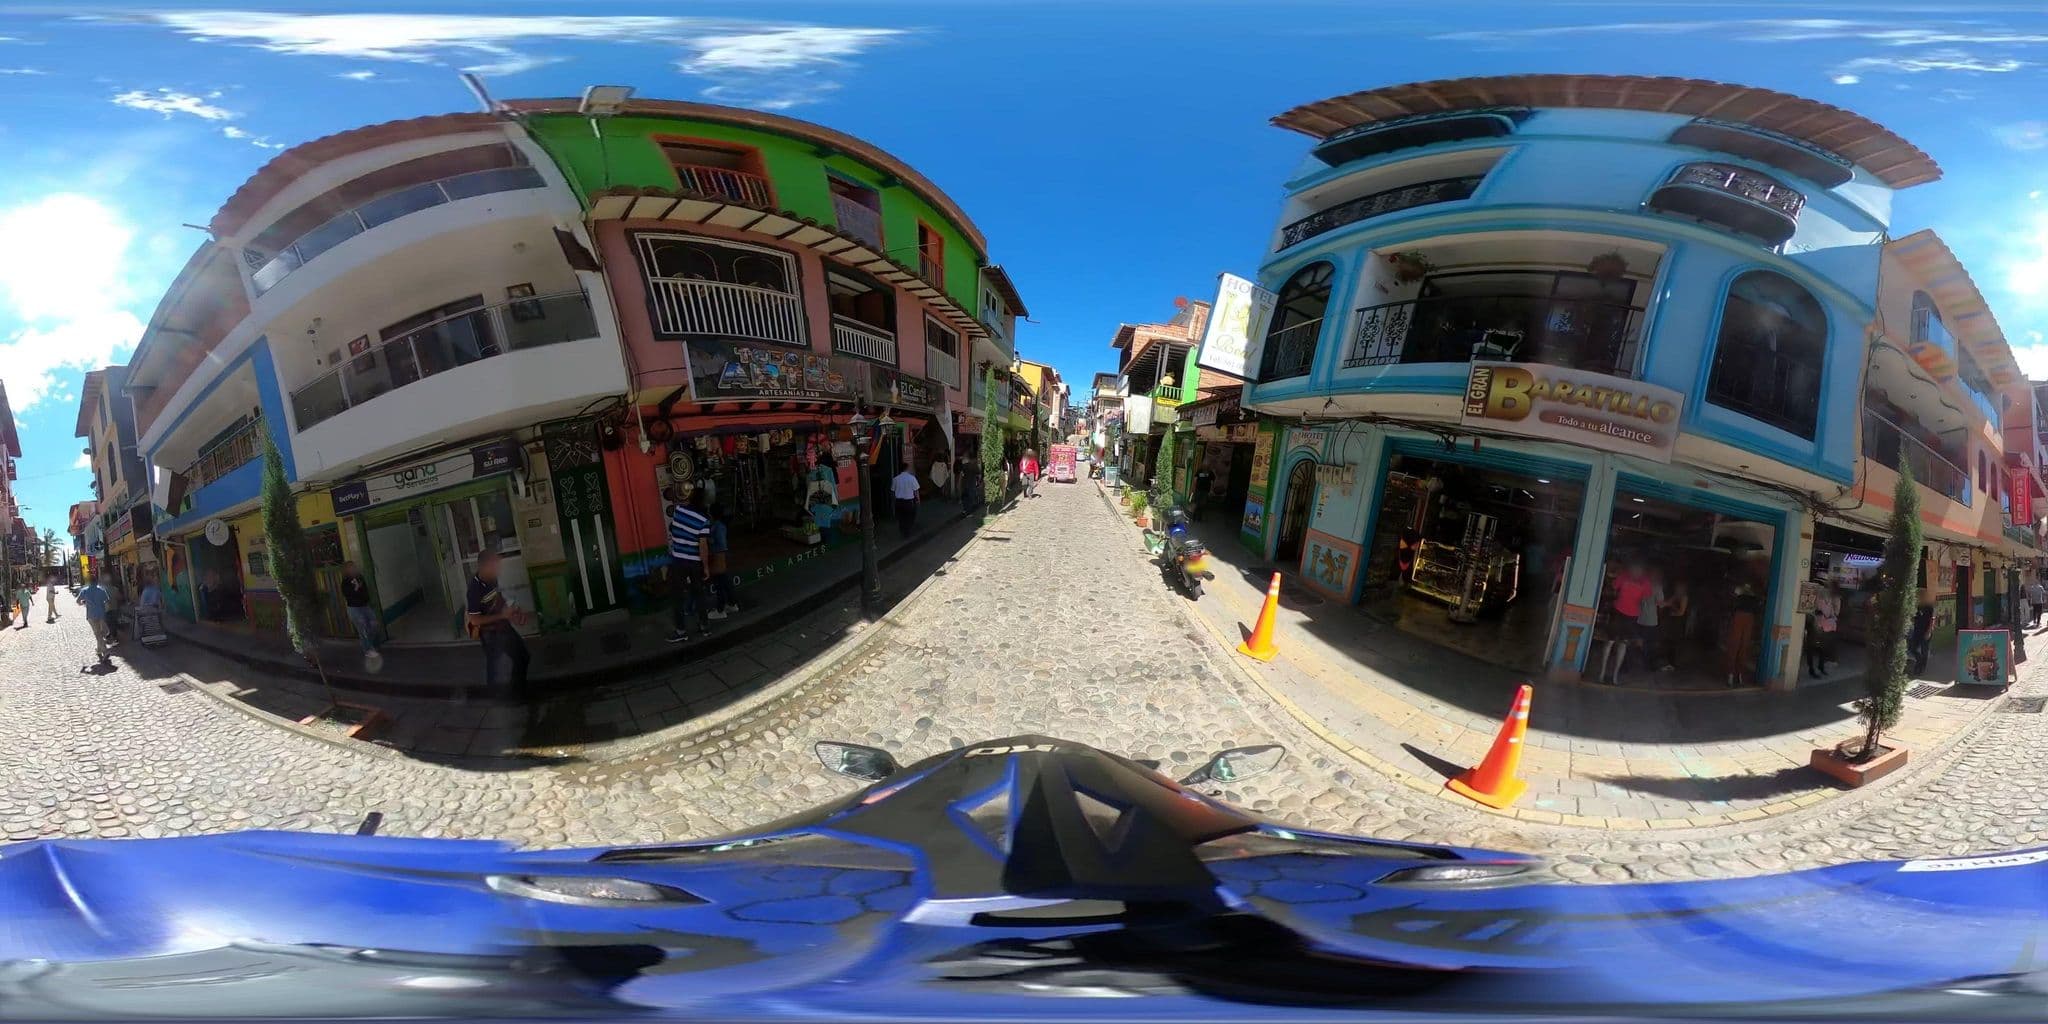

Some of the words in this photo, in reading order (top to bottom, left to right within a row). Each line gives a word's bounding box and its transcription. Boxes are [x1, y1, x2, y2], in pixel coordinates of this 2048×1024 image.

[1226, 277, 1274, 304] HOTEL
[718, 360, 848, 394] ARTES
[1469, 368, 1490, 401] GRAN
[1466, 402, 1485, 416] EL
[1485, 366, 1678, 423] BARATILLO
[1557, 415, 1579, 427] Todo
[1587, 421, 1598, 431] tu
[1599, 420, 1653, 444] alcance
[2015, 479, 2025, 520] HOTEL
[756, 565, 774, 578] EN
[787, 545, 827, 566] ARTES
